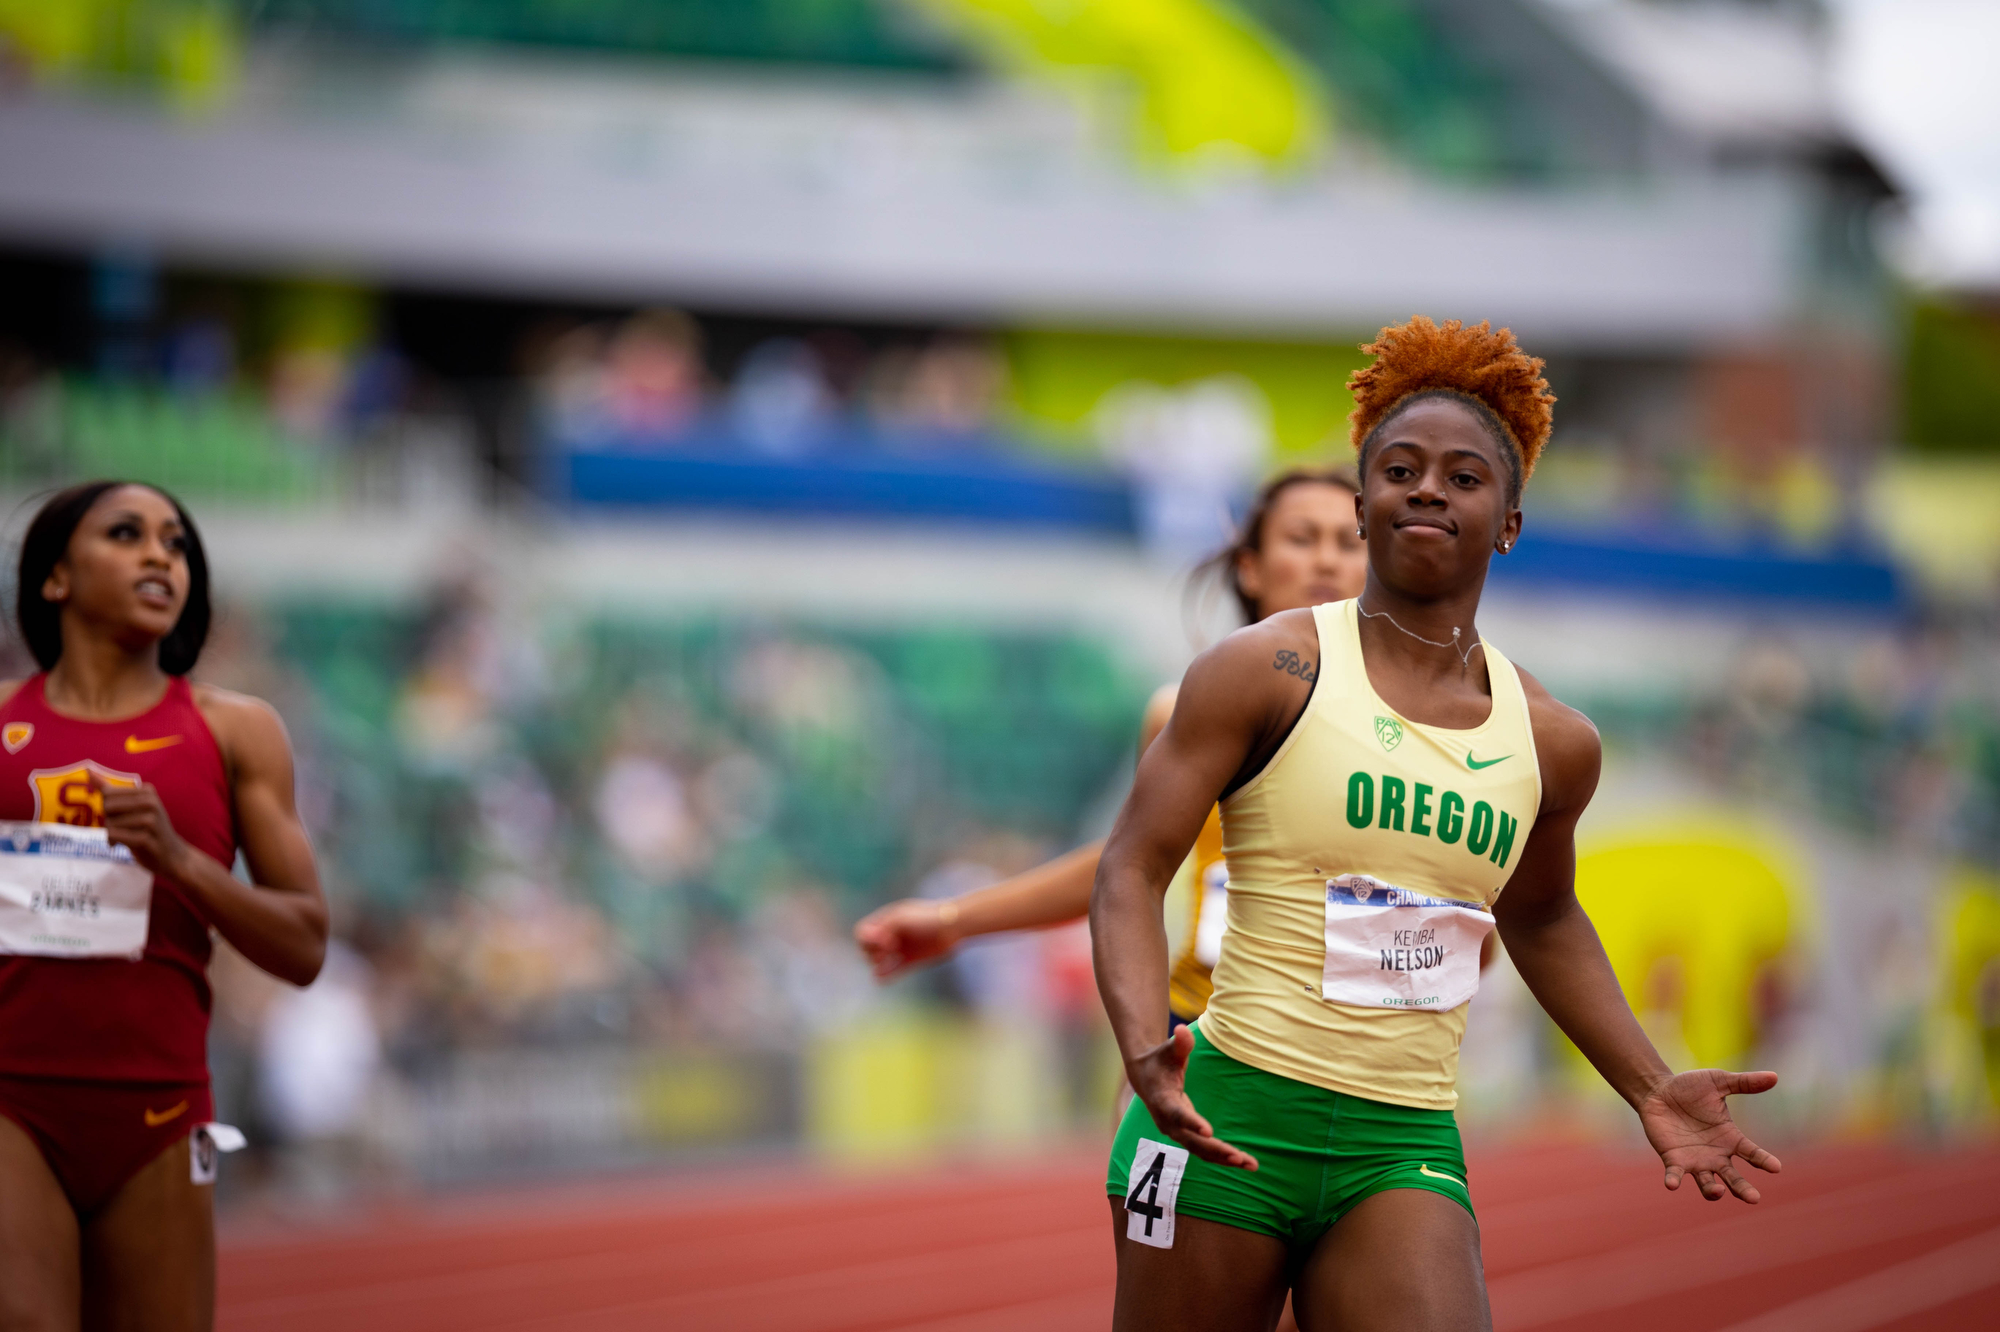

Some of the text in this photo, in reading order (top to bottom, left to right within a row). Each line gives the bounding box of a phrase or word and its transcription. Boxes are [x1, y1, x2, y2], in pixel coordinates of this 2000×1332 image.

[1376, 718, 1401, 740] PAC
[1382, 731, 1396, 746] 12
[1346, 771, 1518, 869] OREGON
[1394, 928, 1435, 946] KEMBA
[1380, 945, 1443, 971] NELSON
[1126, 1151, 1166, 1237] 4
